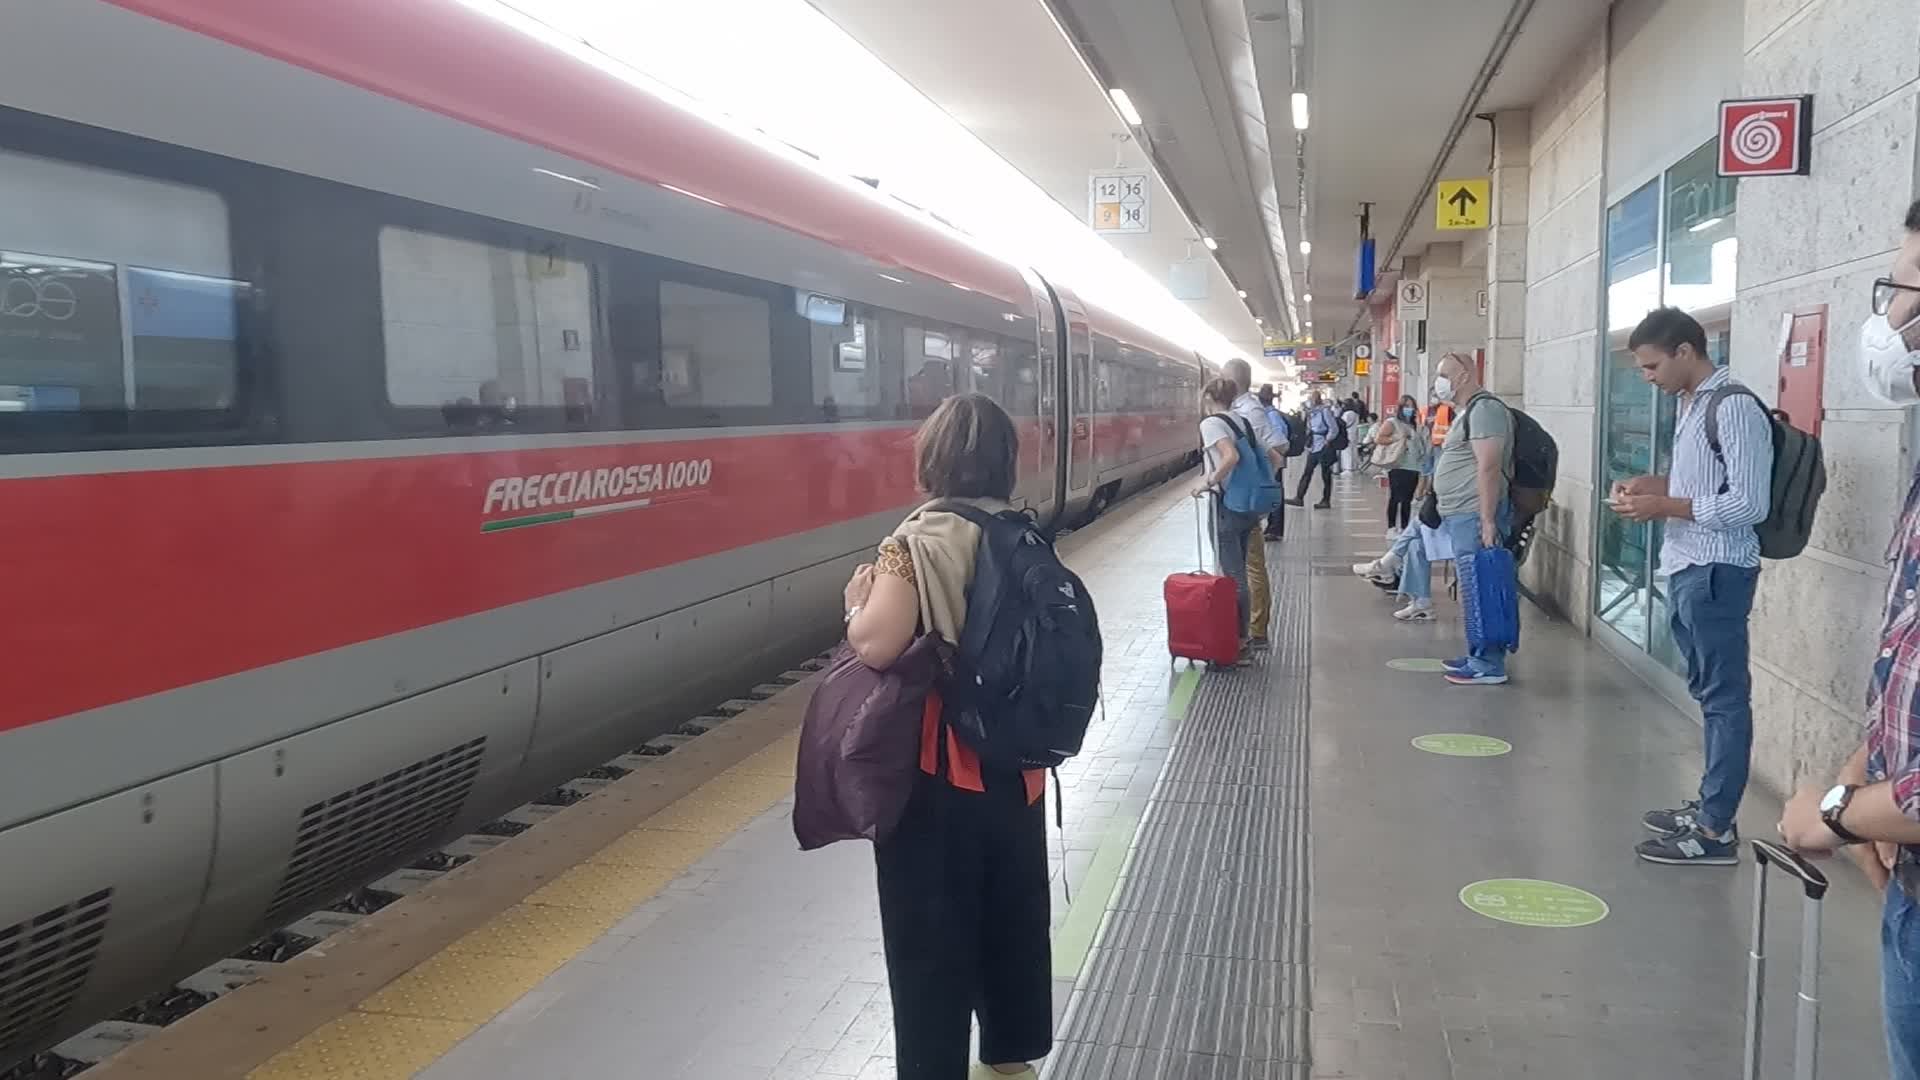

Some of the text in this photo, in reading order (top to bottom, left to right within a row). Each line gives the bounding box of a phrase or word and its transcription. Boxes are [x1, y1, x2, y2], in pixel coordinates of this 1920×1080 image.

[1101, 183, 1116, 196] 12
[1103, 209, 1141, 222] 9 18
[483, 459, 713, 514] FRECCIAROSSA 1000
